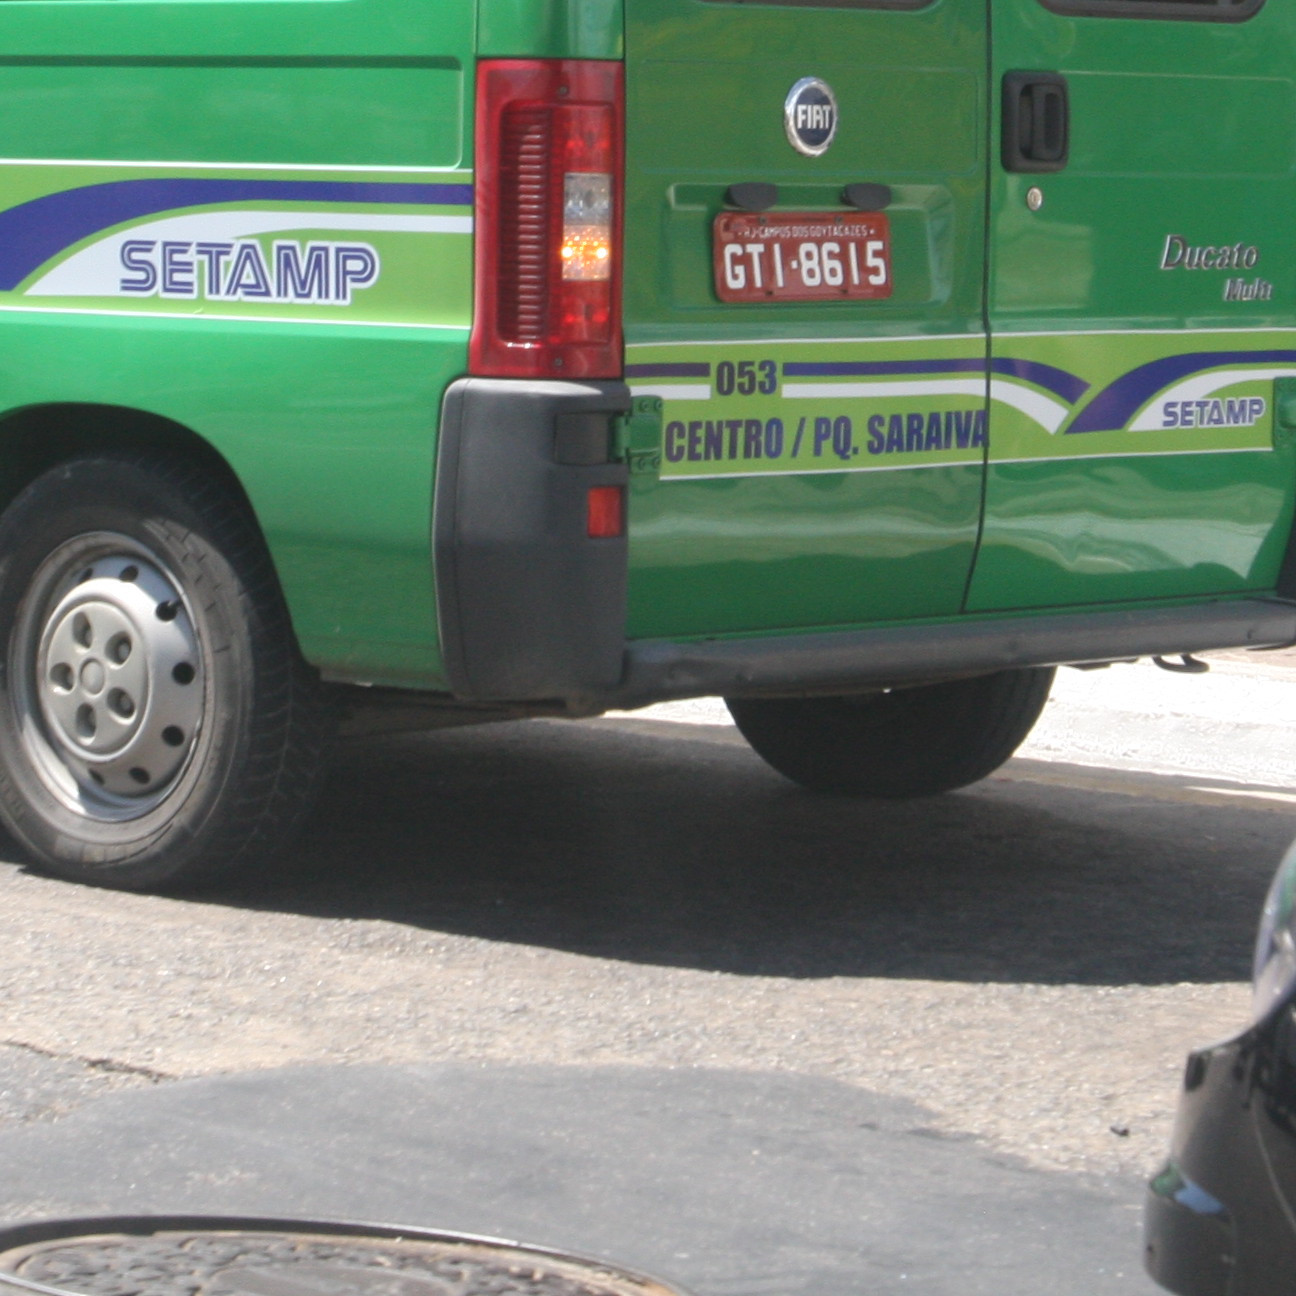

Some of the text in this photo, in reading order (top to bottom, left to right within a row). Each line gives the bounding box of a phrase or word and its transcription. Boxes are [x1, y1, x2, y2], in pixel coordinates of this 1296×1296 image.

[797, 104, 831, 129] FIAT
[1160, 234, 1259, 270] Ducato
[119, 239, 378, 303] SETAMP
[1222, 277, 1273, 302] Multi
[715, 359, 778, 396] 053
[1161, 397, 1265, 428] SETAMP
[664, 409, 989, 463] CENTRO / PQ. SARAIVA
